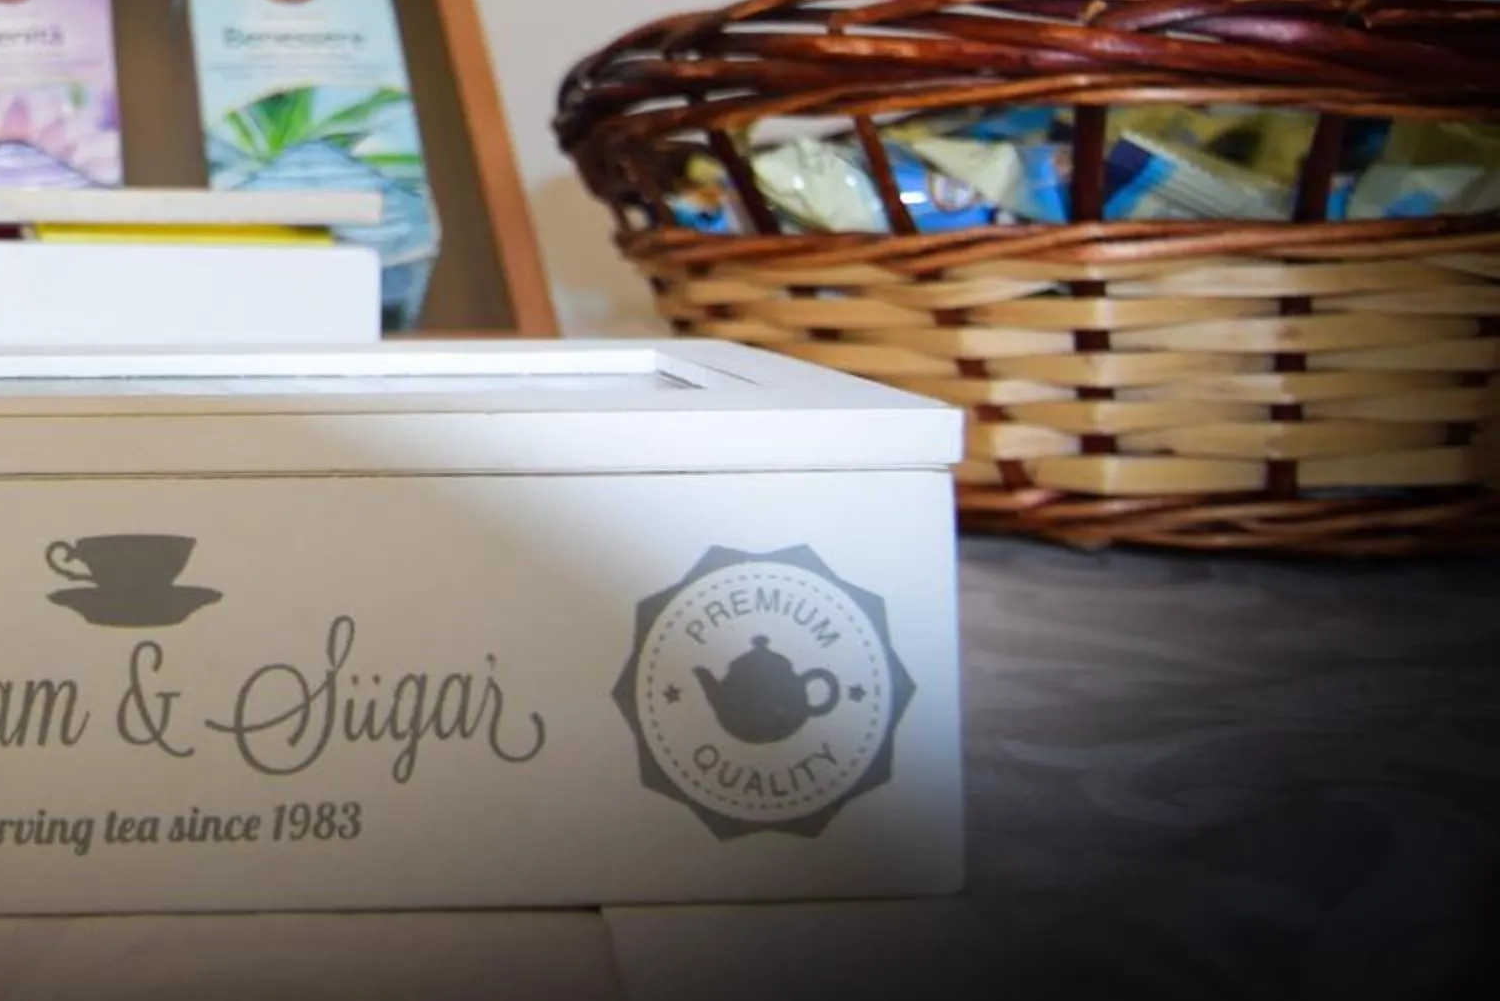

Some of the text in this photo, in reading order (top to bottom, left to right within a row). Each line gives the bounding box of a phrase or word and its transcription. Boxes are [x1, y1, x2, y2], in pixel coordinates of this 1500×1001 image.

[116, 640, 196, 759] &
[692, 742, 840, 799] QUALITY
[103, 810, 161, 845] tea
[167, 806, 262, 844] since
[271, 800, 363, 843] 1983
